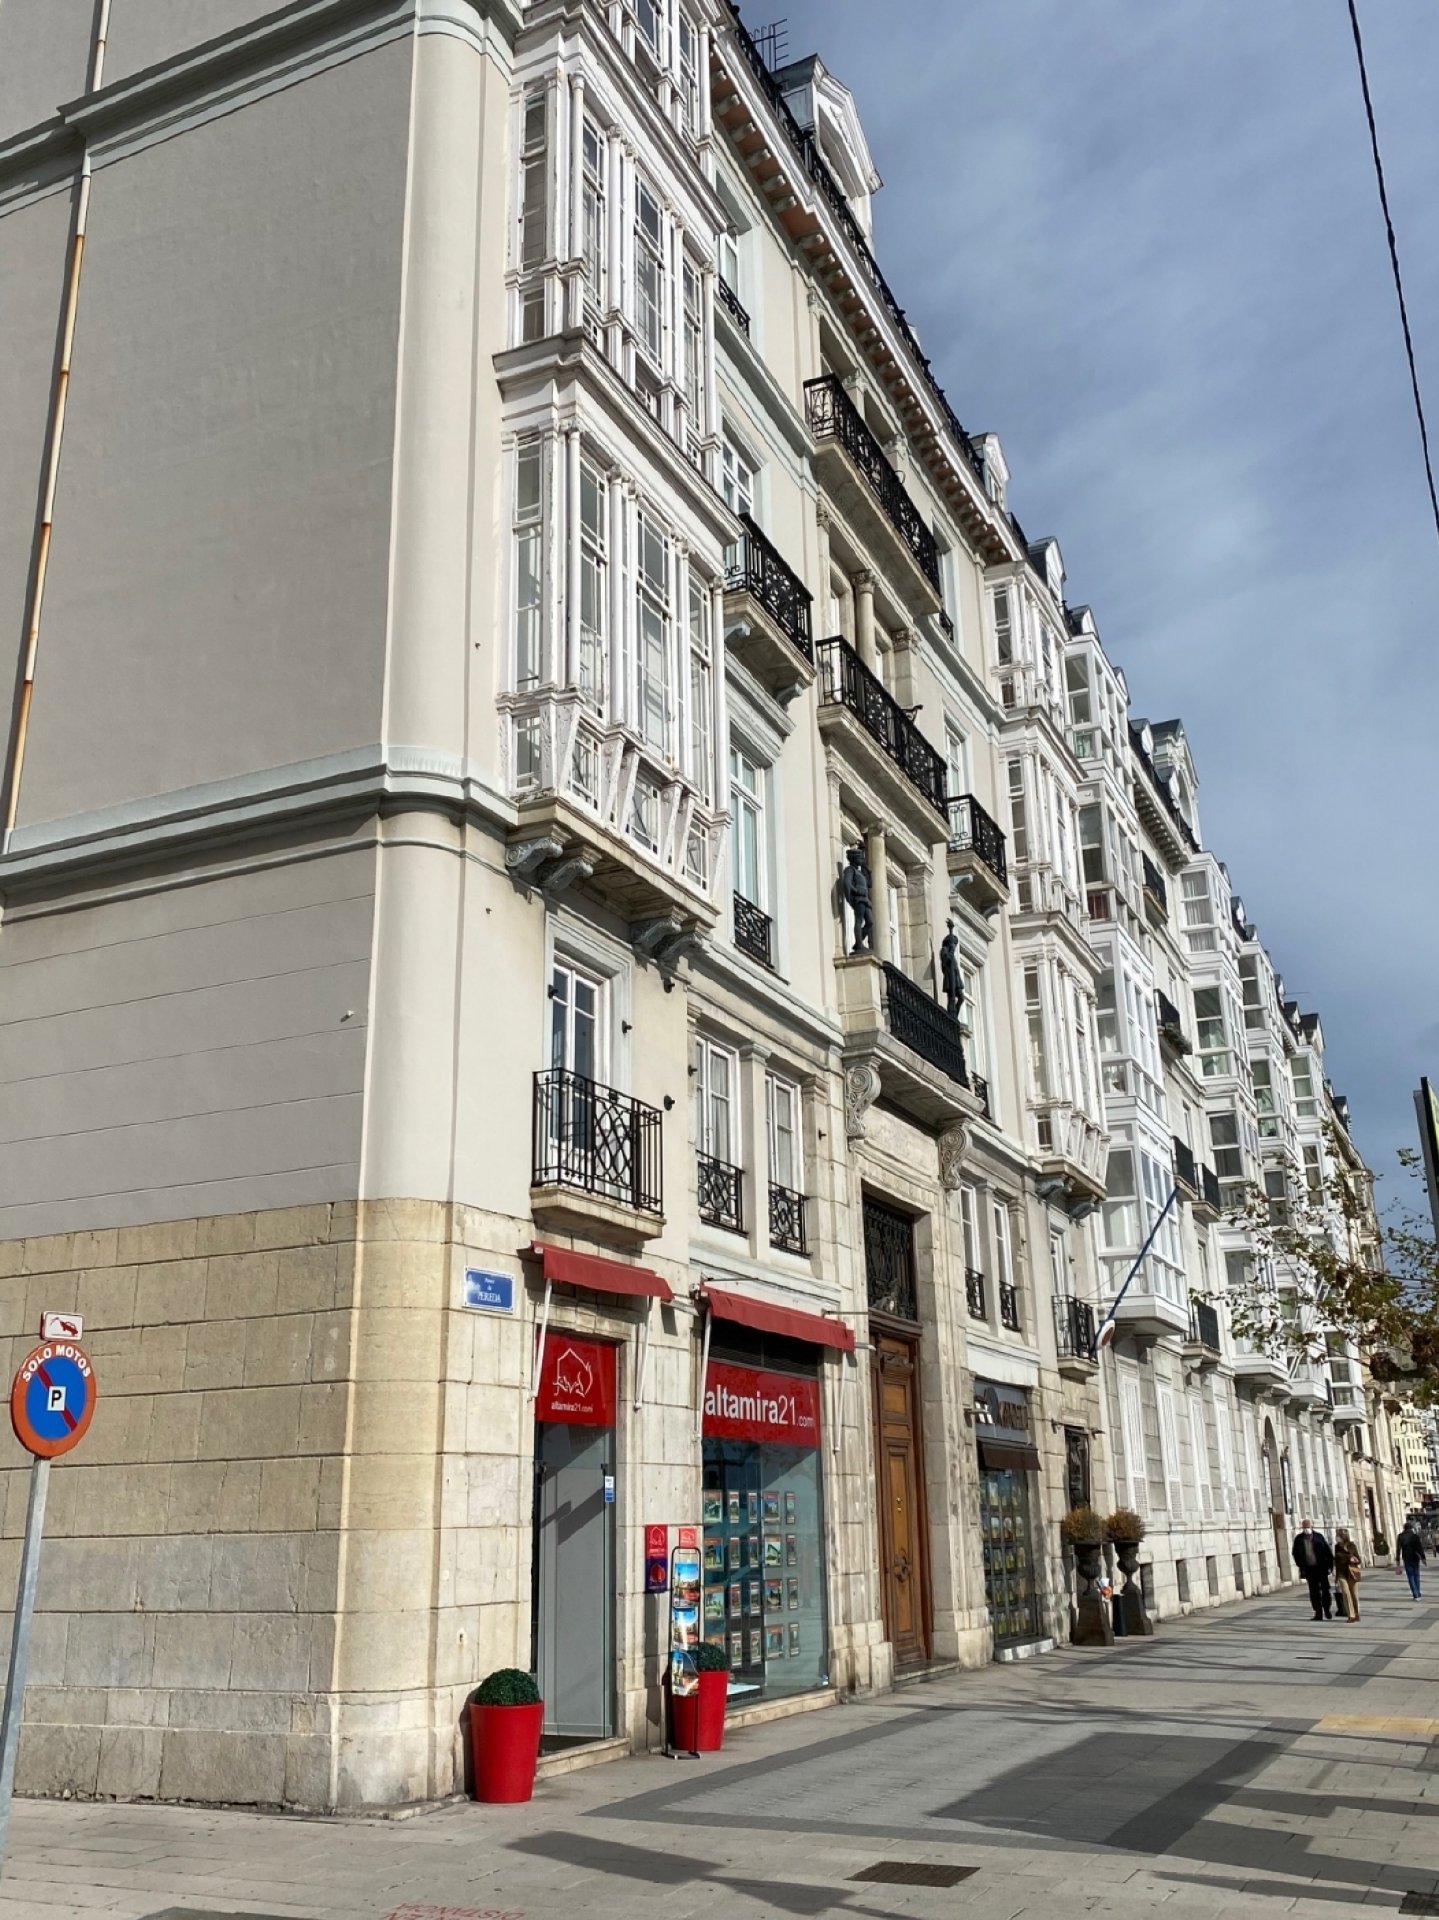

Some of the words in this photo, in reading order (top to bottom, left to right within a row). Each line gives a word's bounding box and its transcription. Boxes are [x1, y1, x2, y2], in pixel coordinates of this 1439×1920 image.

[22, 1347, 52, 1382] SOLO
[55, 1344, 91, 1377] MOTOS
[51, 1389, 62, 1408] P
[704, 1384, 815, 1427] altamira21.com
